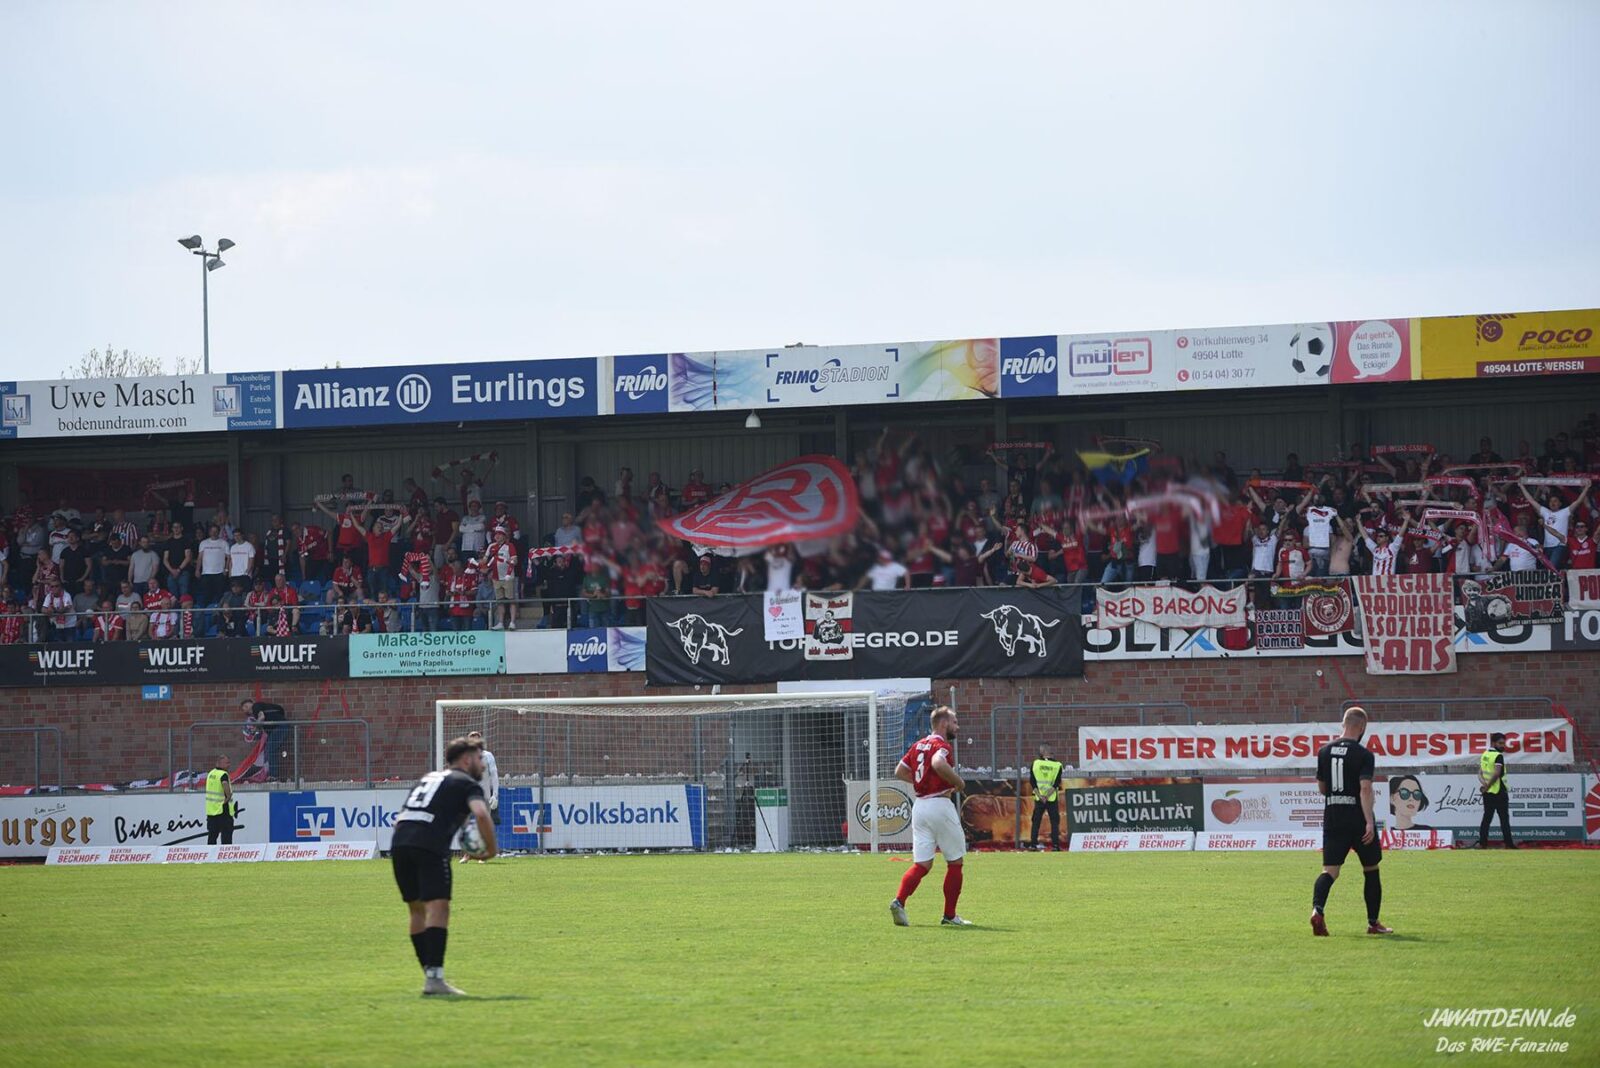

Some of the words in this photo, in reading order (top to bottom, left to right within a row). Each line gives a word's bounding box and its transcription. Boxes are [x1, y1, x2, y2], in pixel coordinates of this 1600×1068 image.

[1257, 334, 1268, 344] 34
[1519, 327, 1593, 346] POCO
[1076, 349, 1145, 365] müller
[1192, 351, 1219, 360] 49504
[1221, 349, 1244, 359] Lotte
[1002, 356, 1057, 375] FRIMO
[1483, 364, 1512, 373] 49504
[1513, 361, 1585, 372] LOTTE-WERSEN
[452, 372, 585, 407] Eurlings
[615, 373, 668, 393] FRIMO
[48, 385, 105, 410] Uwe
[115, 380, 196, 408] Masch
[294, 382, 390, 410] Allianz
[58, 416, 188, 432] bodenundraum.com
[1358, 574, 1453, 594] ILLEGALE
[1105, 597, 1146, 617] RED
[1153, 595, 1239, 615] BARONS
[1361, 594, 1453, 615] RADIKALE
[378, 632, 477, 648] MaRa-Service
[148, 647, 205, 666] WULFF
[260, 644, 318, 663] WULFF
[363, 650, 398, 660] Garten-
[399, 650, 416, 659] und
[418, 648, 492, 660] Friedhofspflege
[568, 643, 608, 657] FRIMO
[38, 650, 95, 669] WULFF
[399, 660, 422, 668] Wilma
[159, 685, 169, 699] P
[1086, 736, 1217, 761] MEISTER
[1225, 734, 1342, 759] MÜSSE
[1364, 730, 1566, 759] AUFSTEGEN
[1331, 757, 1345, 793] 11
[1072, 792, 1111, 807] DEIN
[1115, 790, 1161, 805] GRILL
[341, 805, 398, 829] Volks
[558, 800, 680, 825] Volksbank
[1073, 808, 1112, 824] WILL
[1115, 803, 1194, 823] QUALITÄT
[2, 816, 94, 846] urger
[115, 816, 163, 844] Bitte
[167, 814, 204, 832] ein
[1082, 840, 1129, 850] BECKHOFF
[1139, 839, 1187, 849] BECKHOFF
[1208, 839, 1257, 849] BECKHOFF
[1267, 839, 1316, 849] BECKHOFF
[57, 854, 100, 864] BECKHOFF
[109, 853, 152, 863] BECKHOFF
[166, 852, 209, 862] BECKHOFF
[218, 850, 260, 861] BECKHOFF
[327, 849, 369, 858] BECKHOFF
